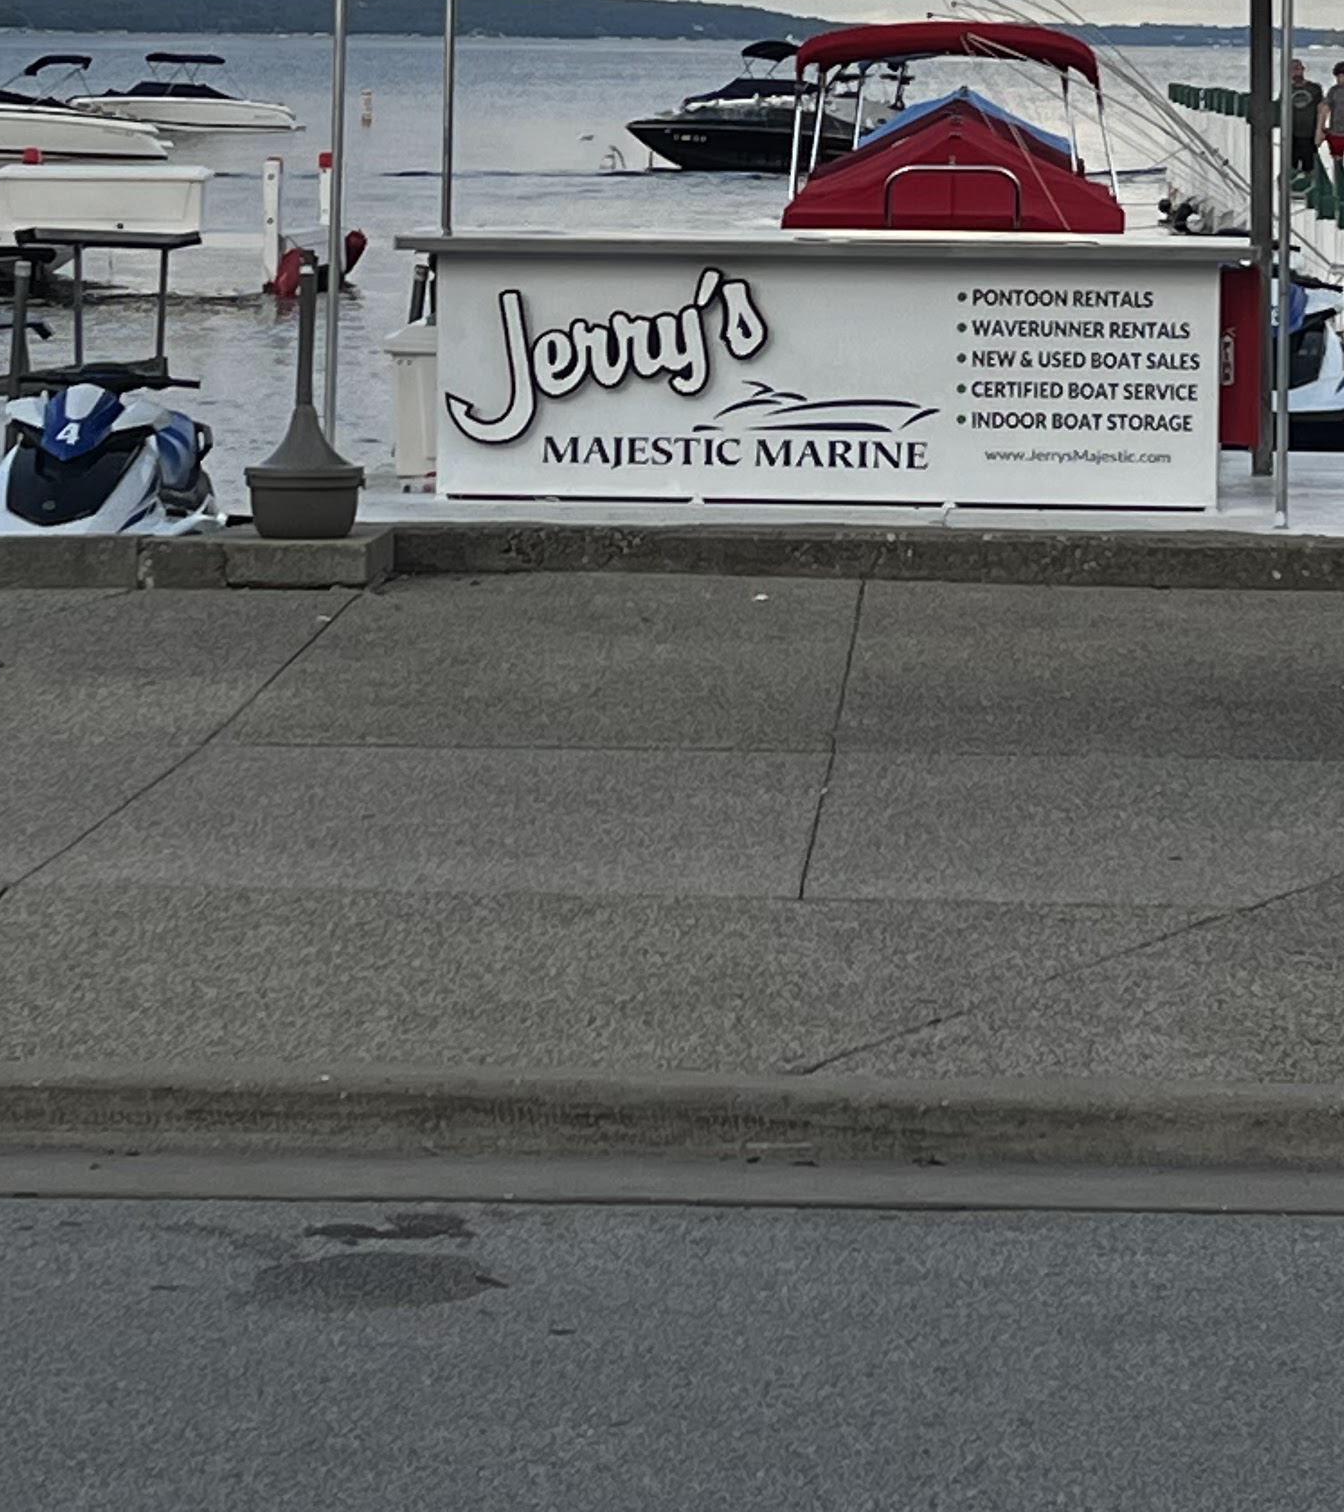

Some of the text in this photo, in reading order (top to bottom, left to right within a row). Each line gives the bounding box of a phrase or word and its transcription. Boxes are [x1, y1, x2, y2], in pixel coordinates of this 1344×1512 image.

[971, 289, 1154, 308] PONTOON RENTALS
[971, 320, 1191, 339] WAVERUNNER RENTALS
[445, 267, 768, 445] Jerry's
[971, 350, 1200, 371] NEW & USED BOAT SALES
[971, 381, 1199, 402] CERTIFIED BOAT SERVICE
[971, 411, 1193, 432] INDOOR BOAT STORAGE
[55, 422, 80, 445] 4
[542, 435, 929, 470] MAJESTIC MARINE
[984, 449, 1171, 465] www.JerrysMajestic.com
